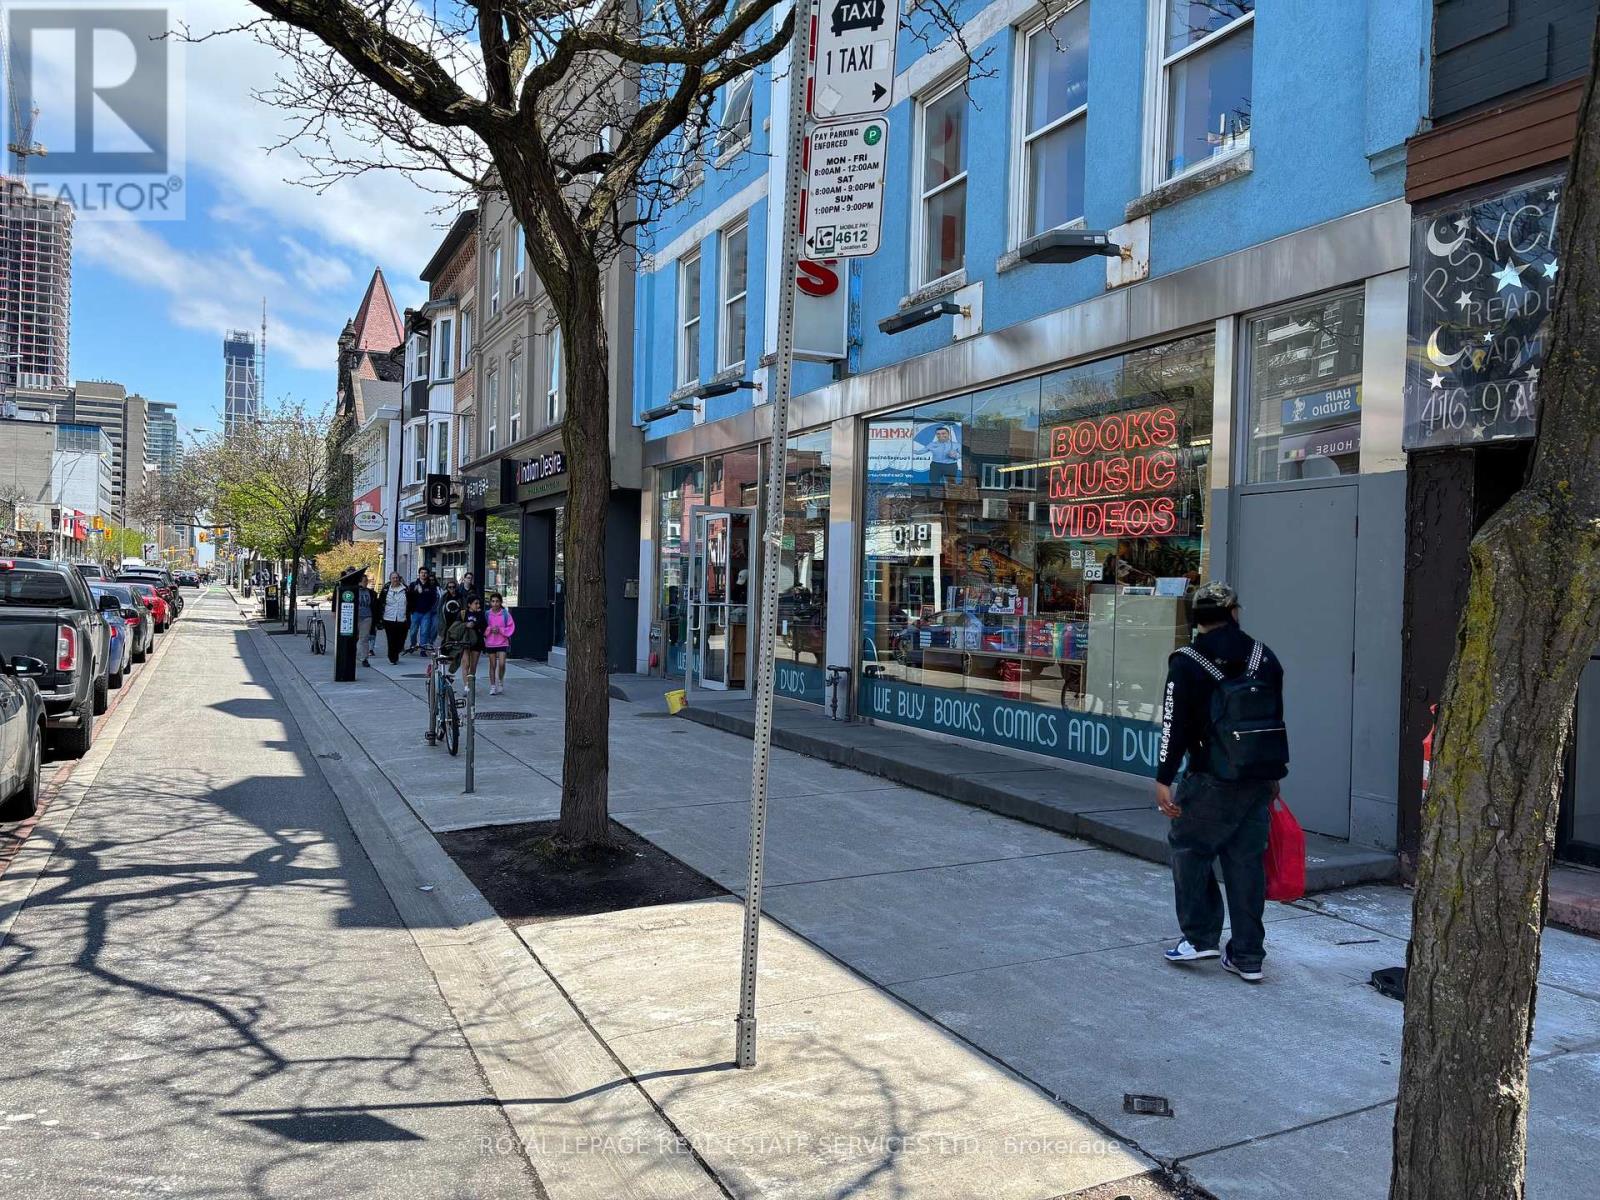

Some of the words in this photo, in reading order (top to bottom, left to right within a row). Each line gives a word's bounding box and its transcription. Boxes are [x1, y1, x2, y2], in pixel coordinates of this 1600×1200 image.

[840, 1, 877, 22] TAXI
[827, 51, 832, 75] 1
[840, 44, 874, 73] TAXI
[814, 132, 828, 141] PAY
[829, 128, 859, 139] PARKING
[814, 140, 848, 150] ENFORCED
[826, 156, 846, 166] MON
[853, 153, 868, 163] FRI
[814, 166, 841, 176] 8:00AM
[848, 162, 879, 173] 12:00AM
[837, 175, 854, 184] SAT
[815, 185, 842, 196] 8:00AM
[848, 182, 875, 192] 9:00PM
[835, 195, 853, 203] SUN
[814, 204, 840, 214] 1:00PM
[846, 202, 874, 211] 9:00PM
[835, 230, 868, 244] 4612
[1050, 408, 1176, 460] BOOKS
[540, 452, 562, 479] Desire
[1049, 451, 1176, 499] MUSIC
[1049, 497, 1176, 537] VIDEOS
[780, 668, 805, 694] DUD'S
[872, 686, 892, 714] WE
[898, 690, 926, 721] BUY
[934, 696, 986, 736] BOOKS,
[993, 706, 1058, 747] COMICS
[1068, 718, 1110, 756] AND
